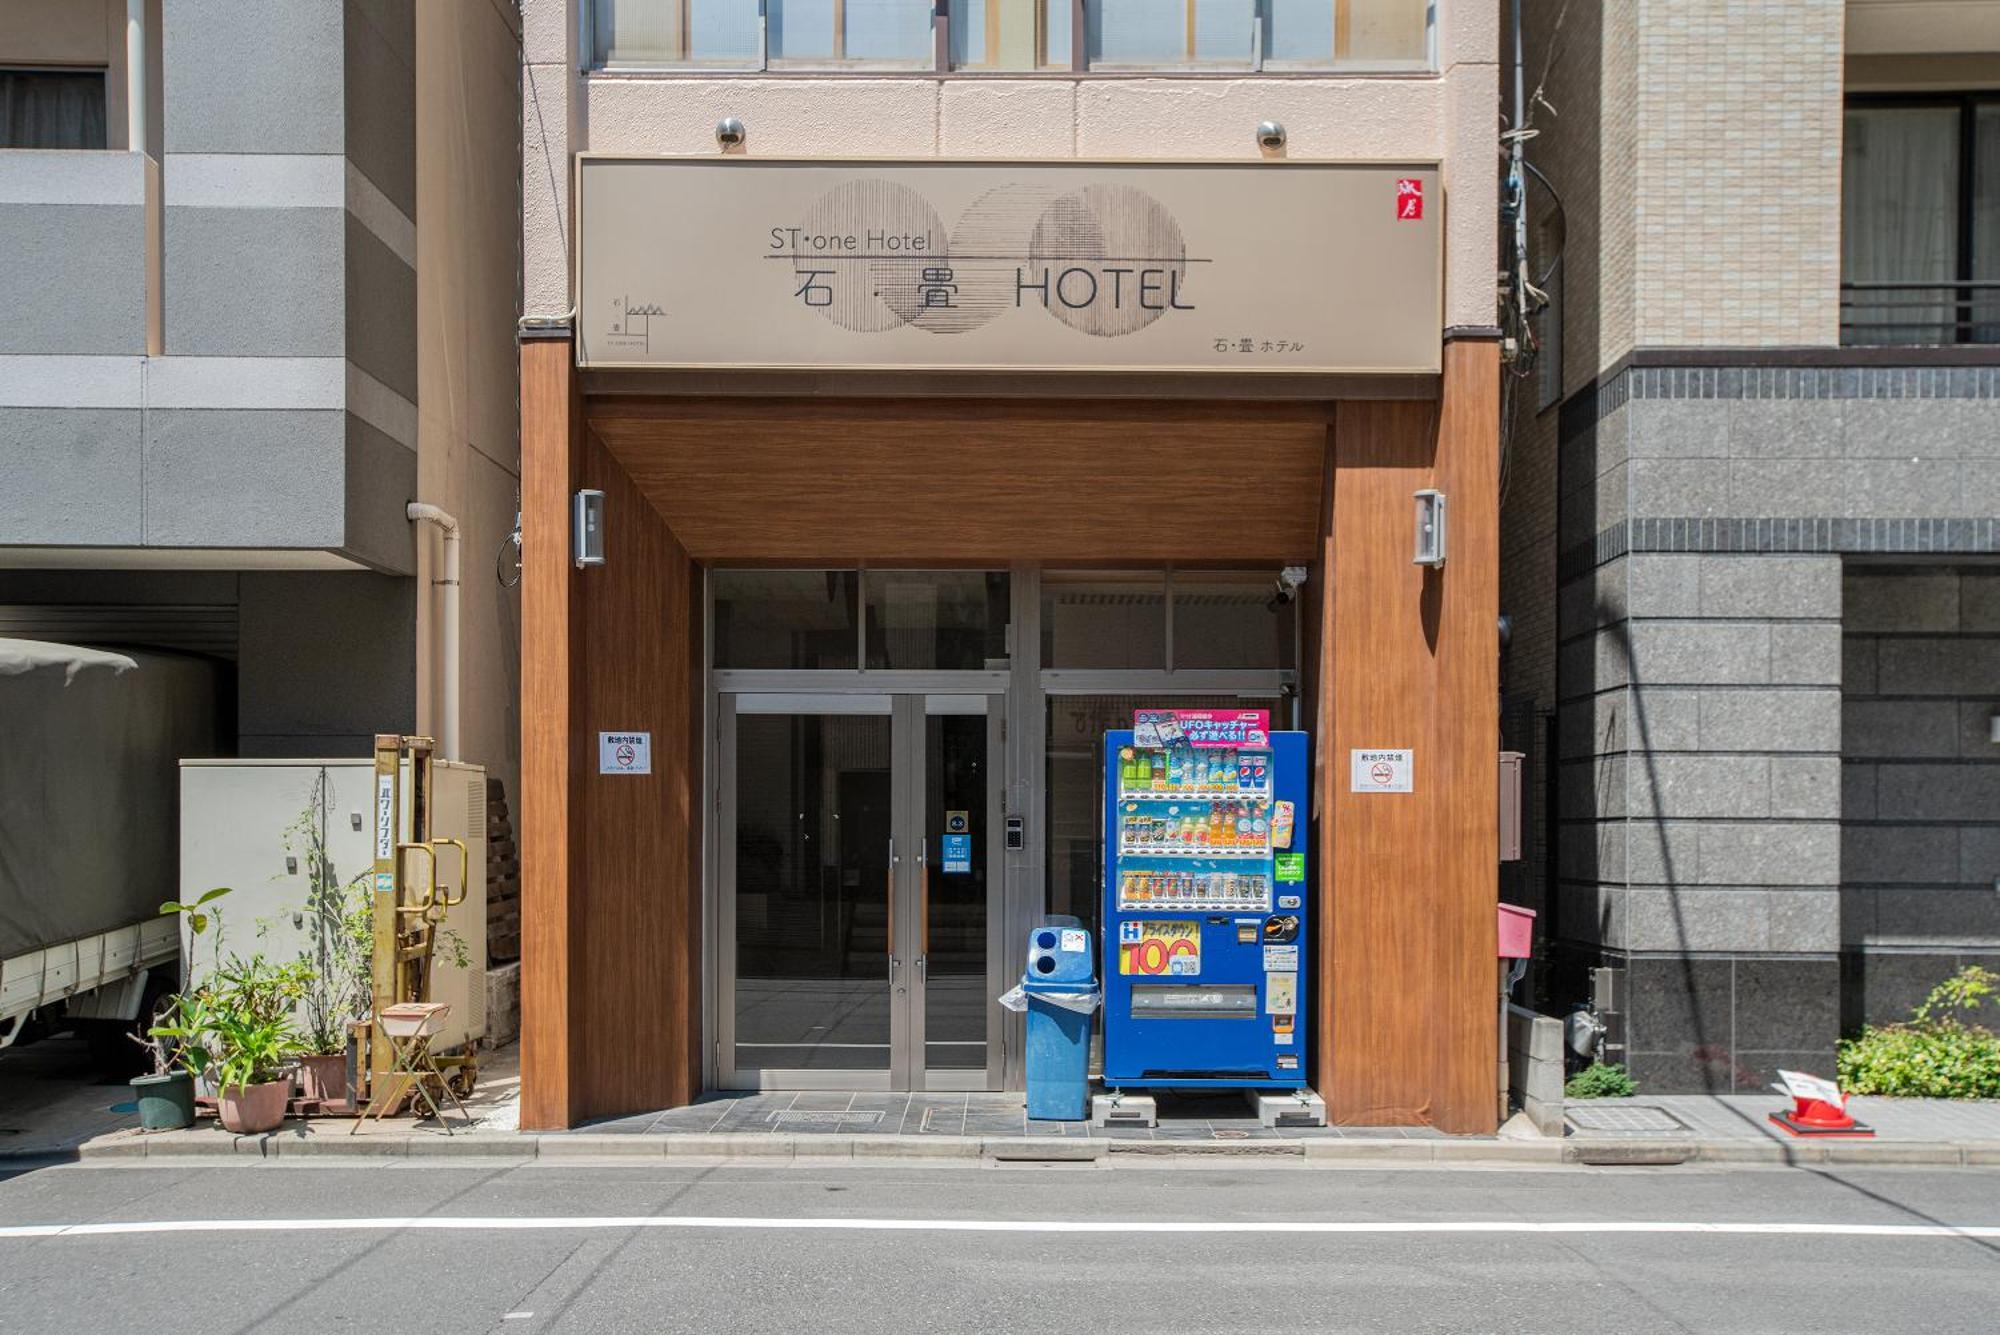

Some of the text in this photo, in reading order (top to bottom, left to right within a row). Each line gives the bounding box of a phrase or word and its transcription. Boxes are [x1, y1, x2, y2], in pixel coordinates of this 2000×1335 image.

[867, 228, 932, 250] Hotel
[1015, 267, 1196, 311] HOTEL
[1260, 340, 1305, 353] ホテル
[1180, 720, 1258, 730] UFOキャッチャー
